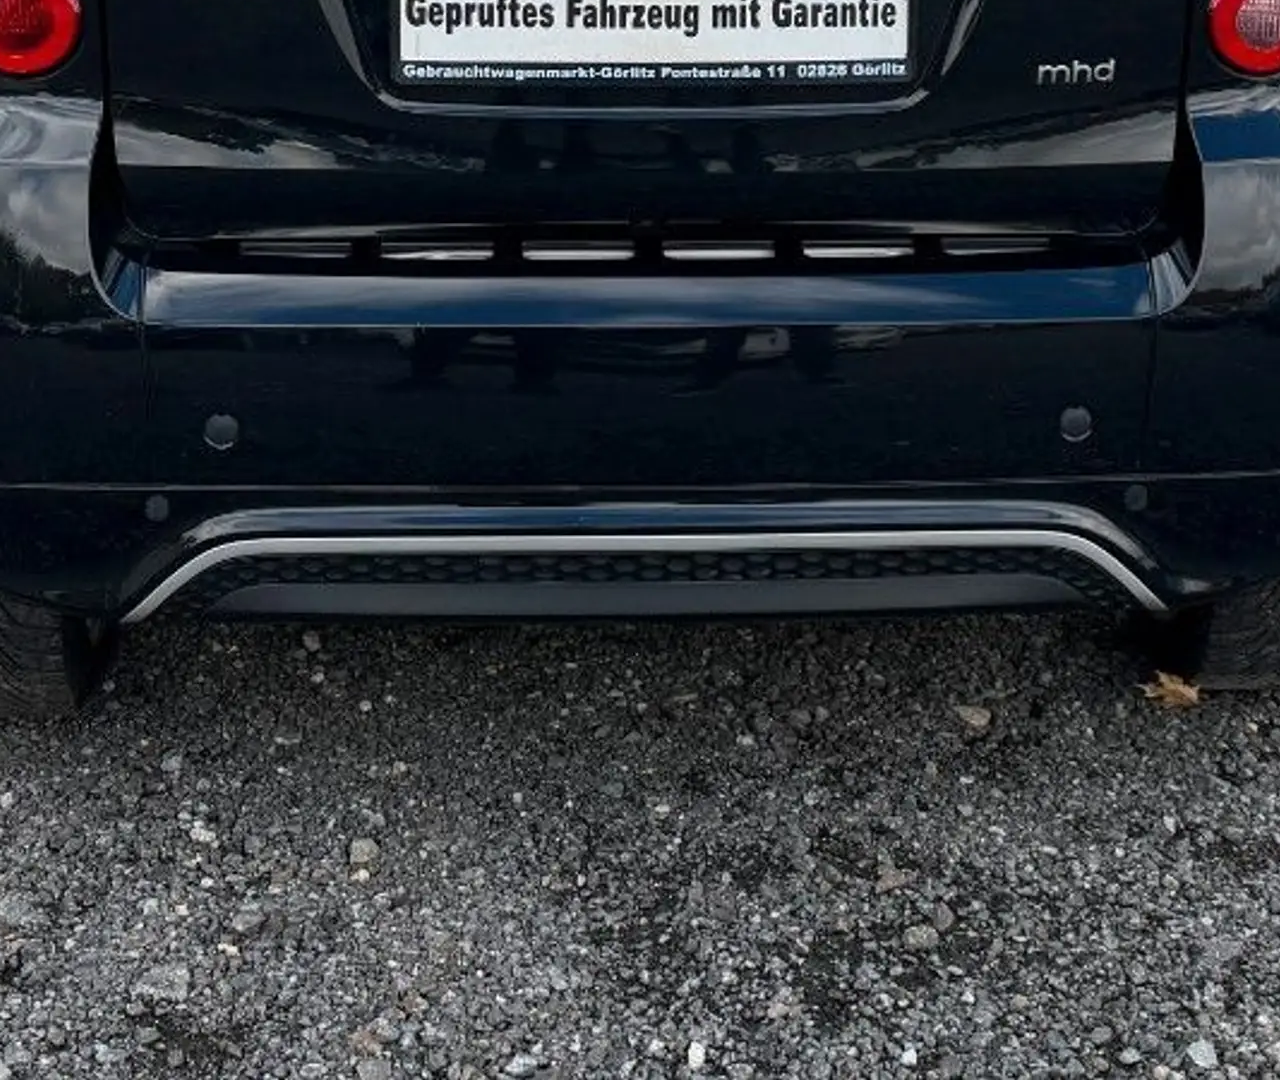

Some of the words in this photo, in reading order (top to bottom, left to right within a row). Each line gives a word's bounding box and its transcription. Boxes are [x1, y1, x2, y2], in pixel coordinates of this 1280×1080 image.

[403, 64, 656, 81] Gebrauchtwagenmarkt-Görlitz
[767, 65, 786, 78] 11
[852, 62, 907, 77] Görlitz
[1037, 57, 1116, 84] mhd
